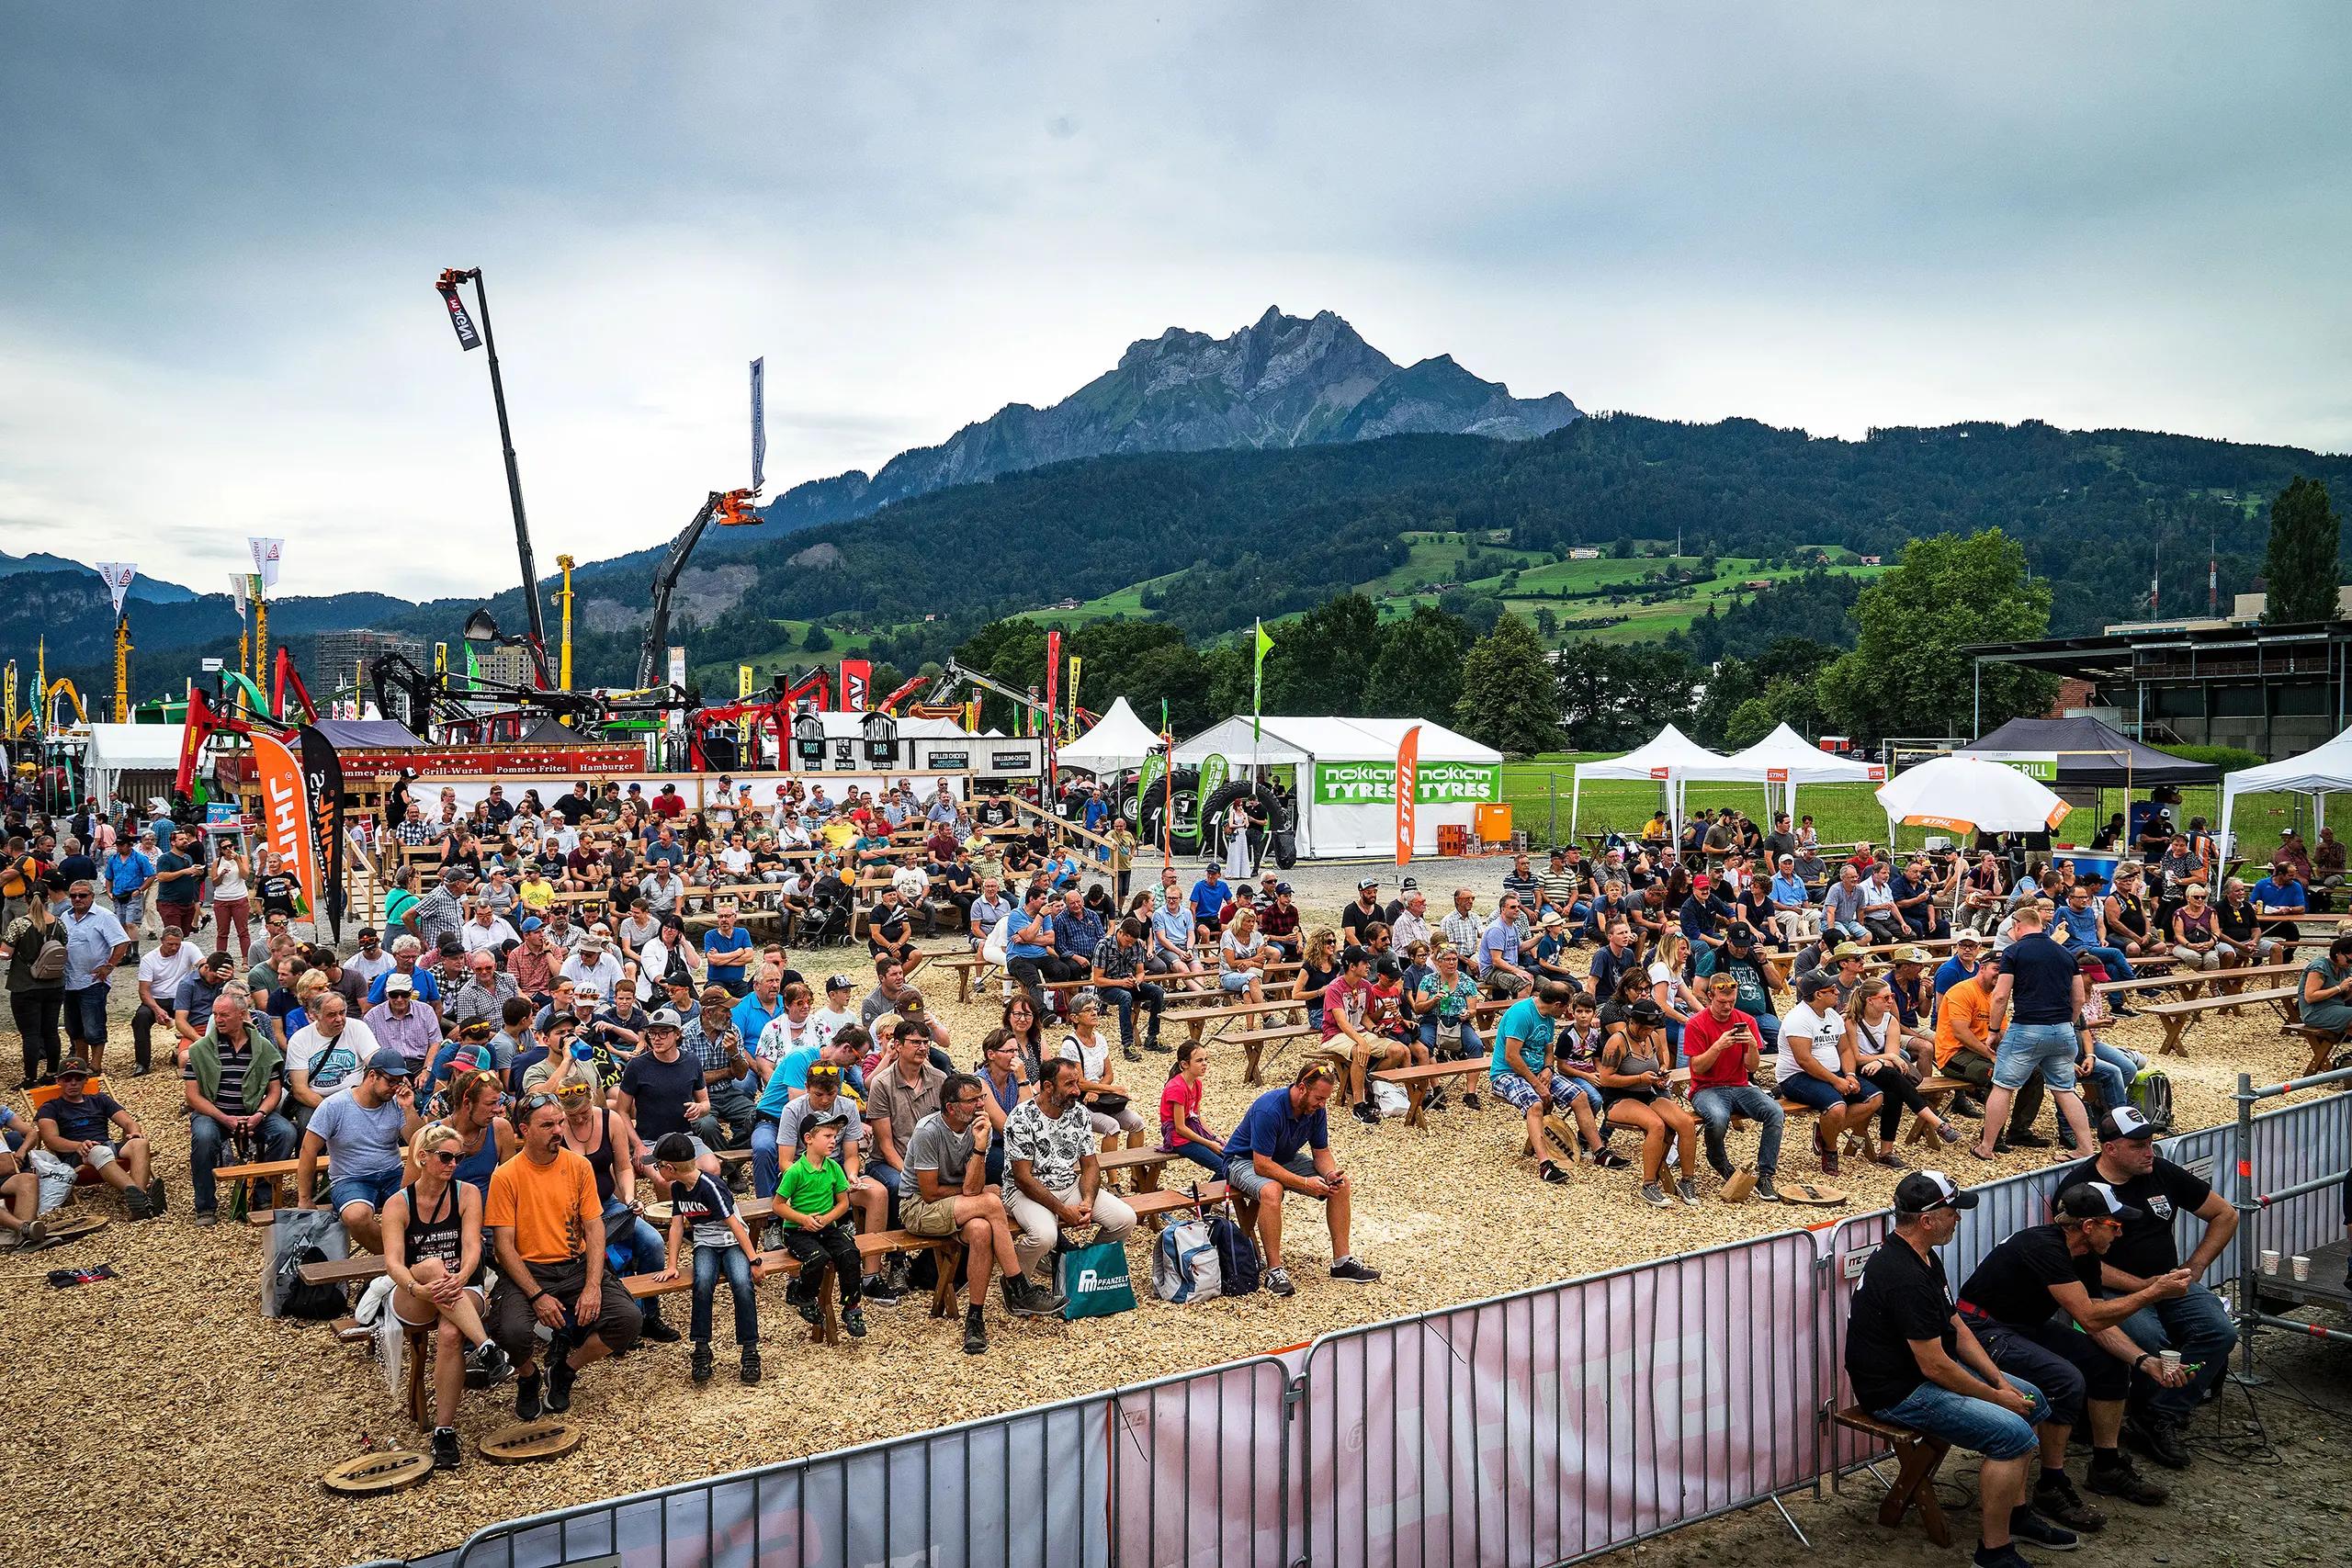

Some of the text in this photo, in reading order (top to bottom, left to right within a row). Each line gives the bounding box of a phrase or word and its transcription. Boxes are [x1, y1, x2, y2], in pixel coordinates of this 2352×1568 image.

[865, 717, 897, 741] CIABATTA
[804, 743, 818, 753] BROT
[874, 744, 888, 755] BAR
[422, 766, 483, 775] Grill-Wurst
[538, 765, 567, 773] Frites
[580, 762, 635, 772] Hamburger
[342, 770, 375, 778] ommes
[1419, 768, 1491, 781] nokian
[1419, 783, 1490, 797] TYRES
[1399, 758, 1412, 848] STIHL
[208, 807, 223, 815] Soft
[1921, 818, 1951, 827] STIHL
[1544, 1125, 1575, 1162] STIHL
[413, 1231, 458, 1244] WARNING
[1098, 1275, 1129, 1286] PFANZELT
